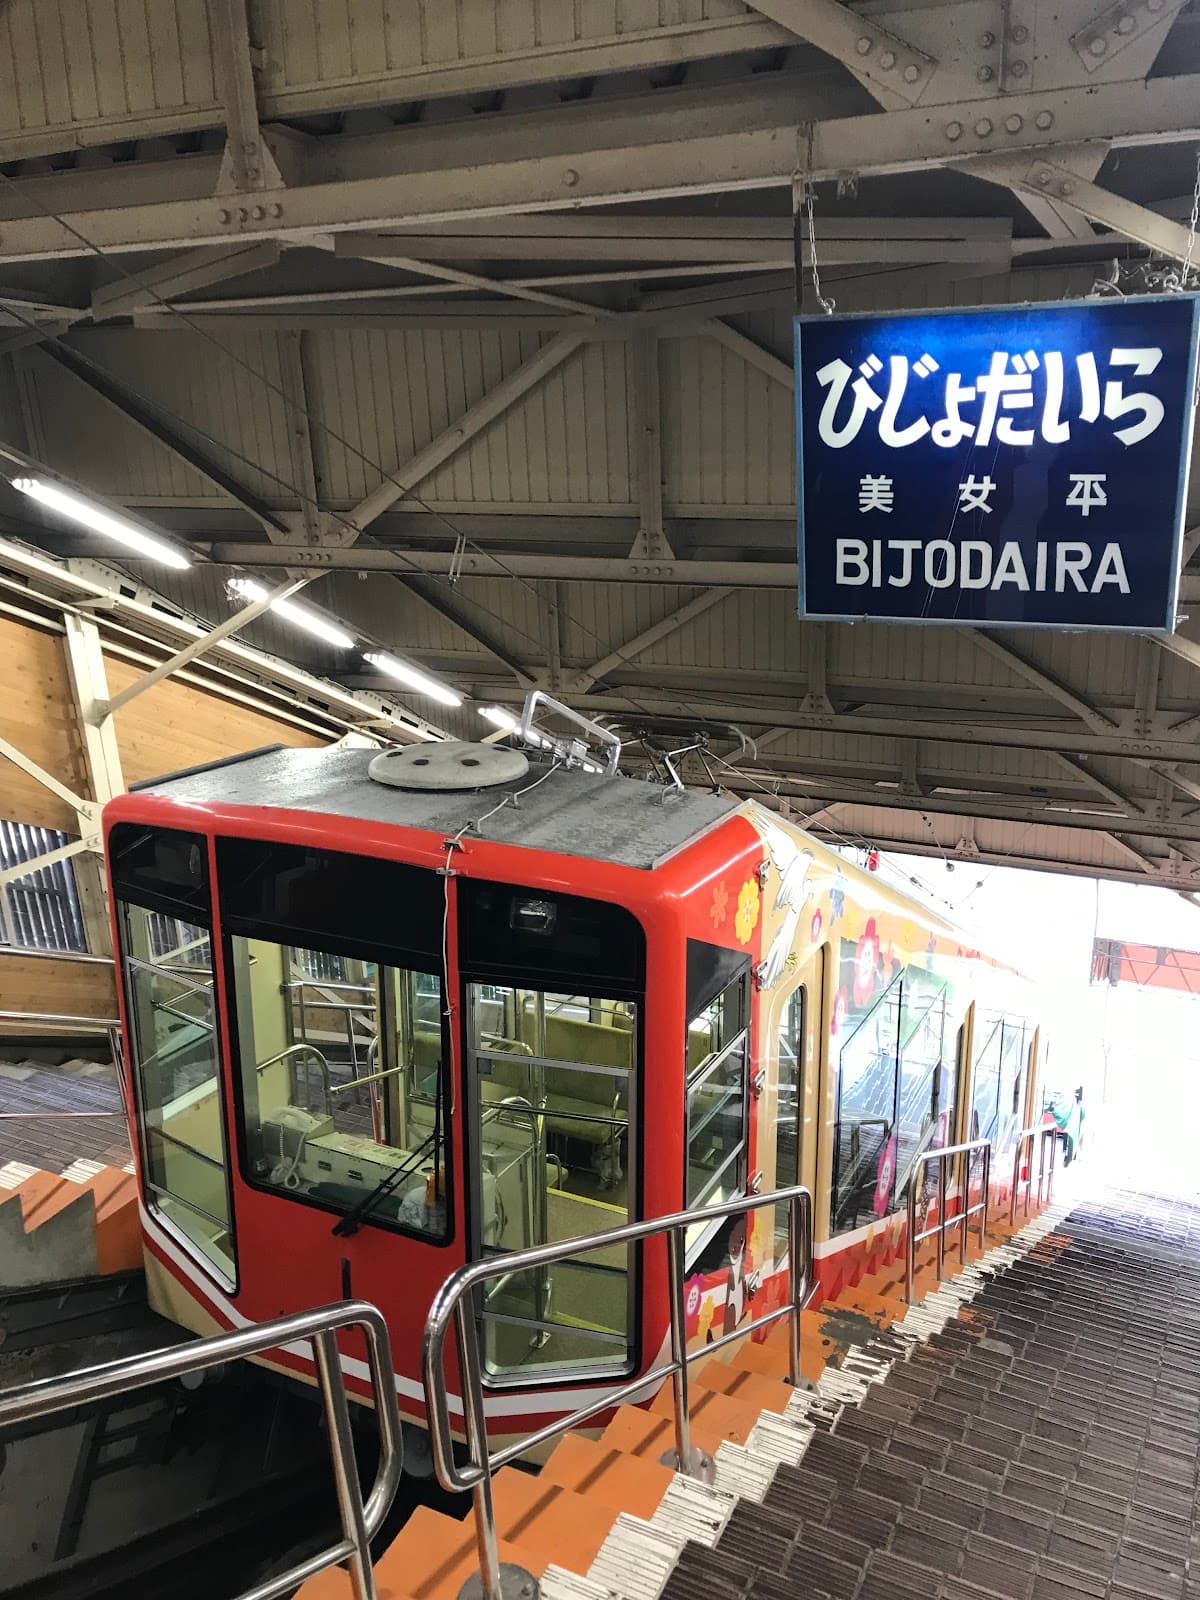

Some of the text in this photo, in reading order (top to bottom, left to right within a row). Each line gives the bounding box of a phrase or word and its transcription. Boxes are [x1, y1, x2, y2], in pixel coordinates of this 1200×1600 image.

[815, 347, 1165, 448] びじょだいら
[835, 538, 1131, 594] BIJODAIRA
